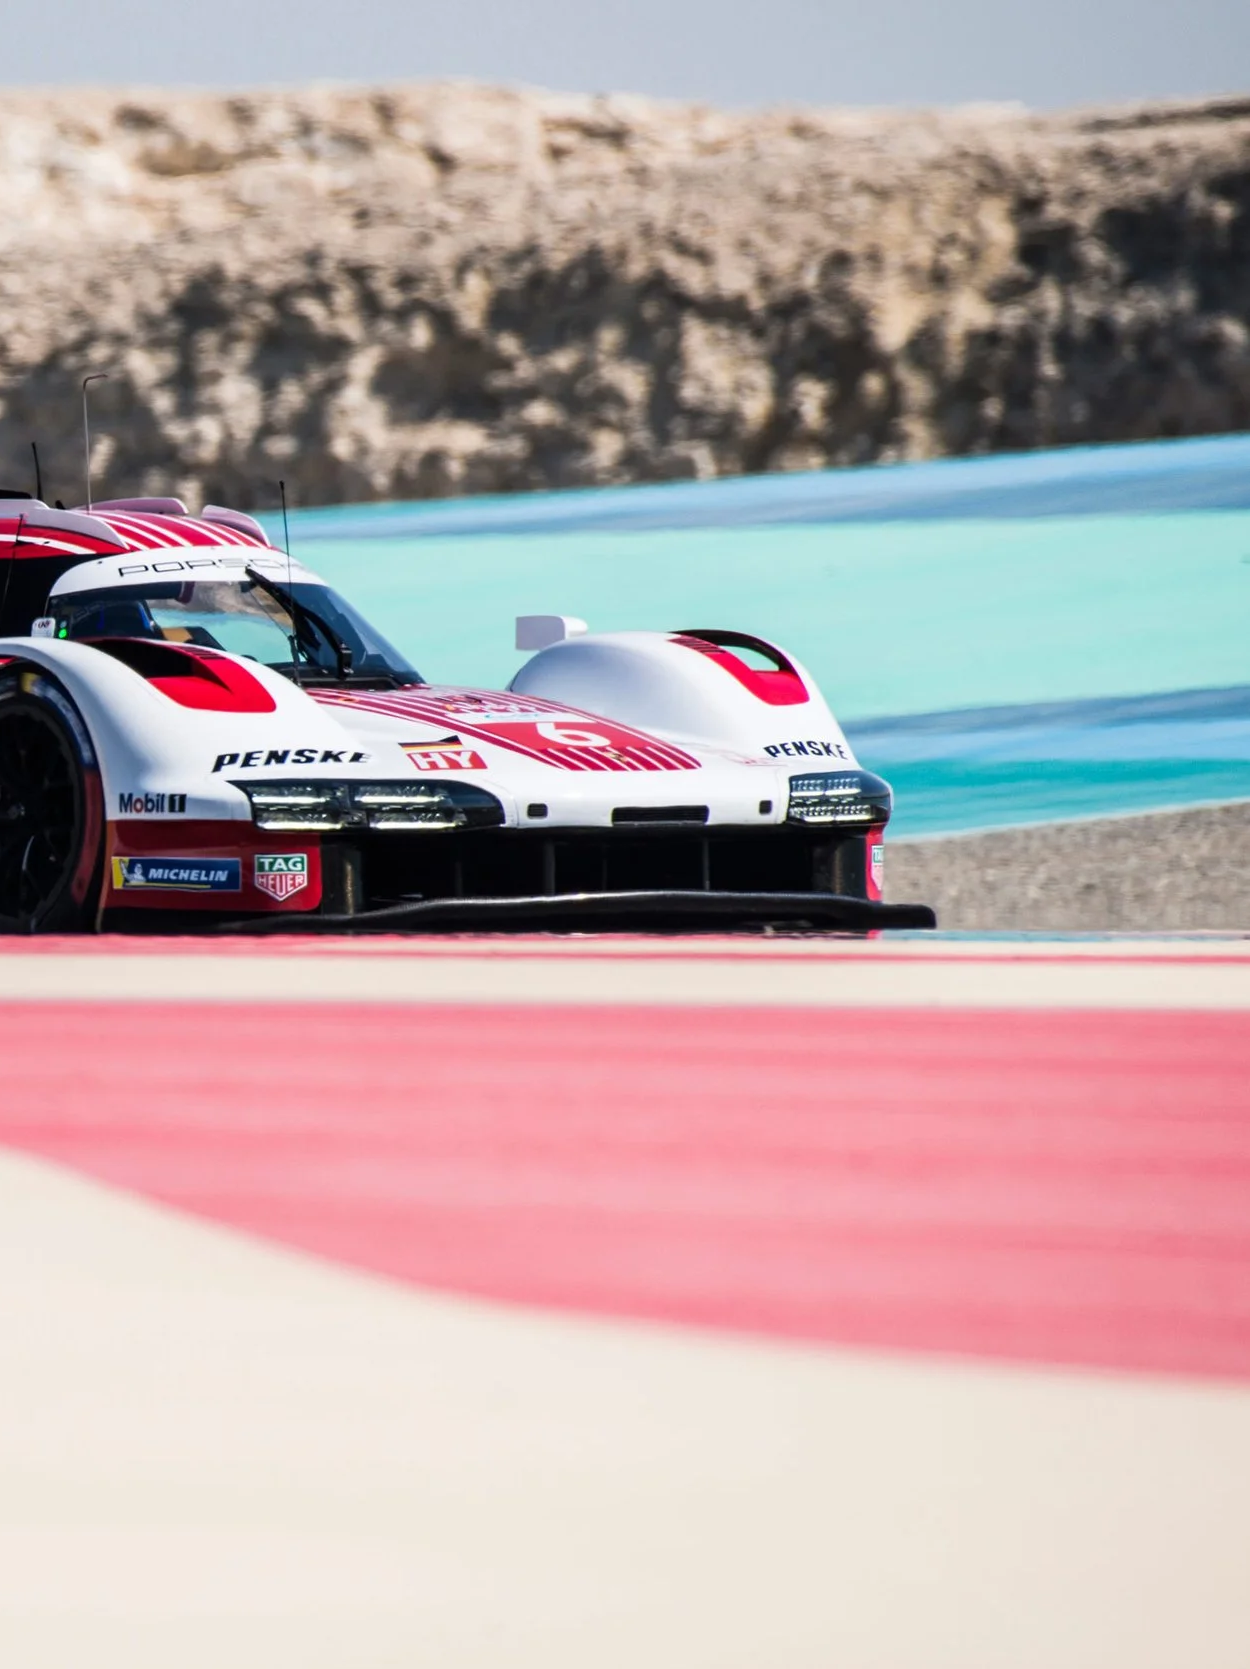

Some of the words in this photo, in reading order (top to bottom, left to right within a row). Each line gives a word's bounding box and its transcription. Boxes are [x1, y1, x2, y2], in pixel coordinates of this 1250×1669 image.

[536, 722, 610, 747] 6
[763, 740, 849, 760] PENSKE
[211, 749, 371, 773] PENSKE
[411, 752, 473, 769] HY
[119, 793, 164, 813] Mobil
[259, 857, 304, 872] TAG
[149, 868, 228, 882] MICHELIN
[258, 873, 304, 897] HEUER
